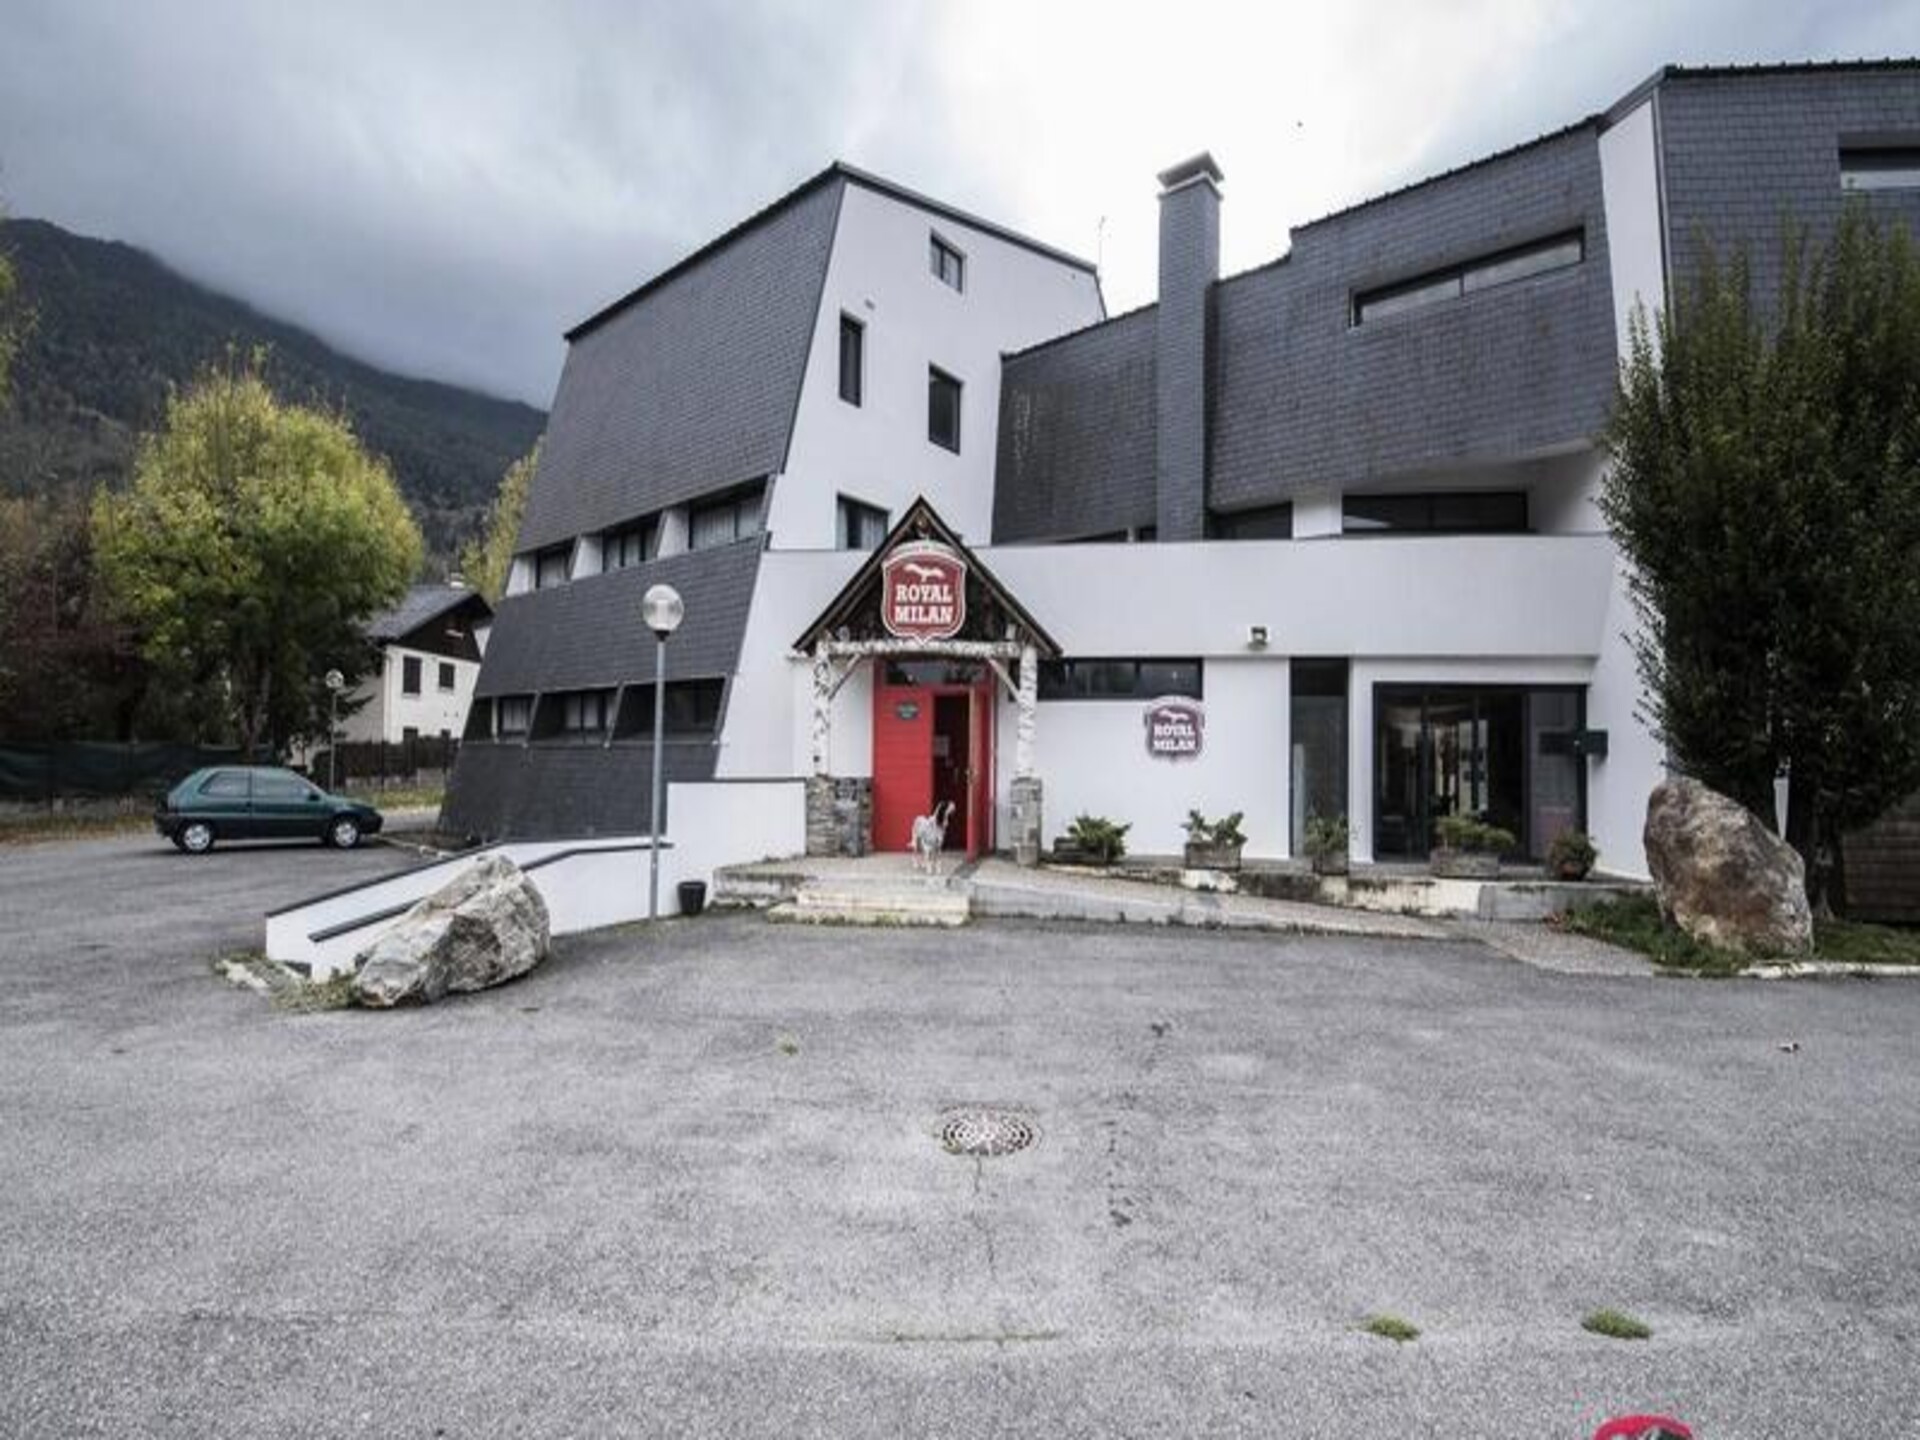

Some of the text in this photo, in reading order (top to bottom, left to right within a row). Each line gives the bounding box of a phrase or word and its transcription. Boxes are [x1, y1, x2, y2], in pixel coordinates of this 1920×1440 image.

[896, 584, 953, 603] ROYAL
[894, 605, 954, 624] MILAN
[1153, 724, 1196, 737] ROYAL
[1153, 740, 1196, 751] MILAN
